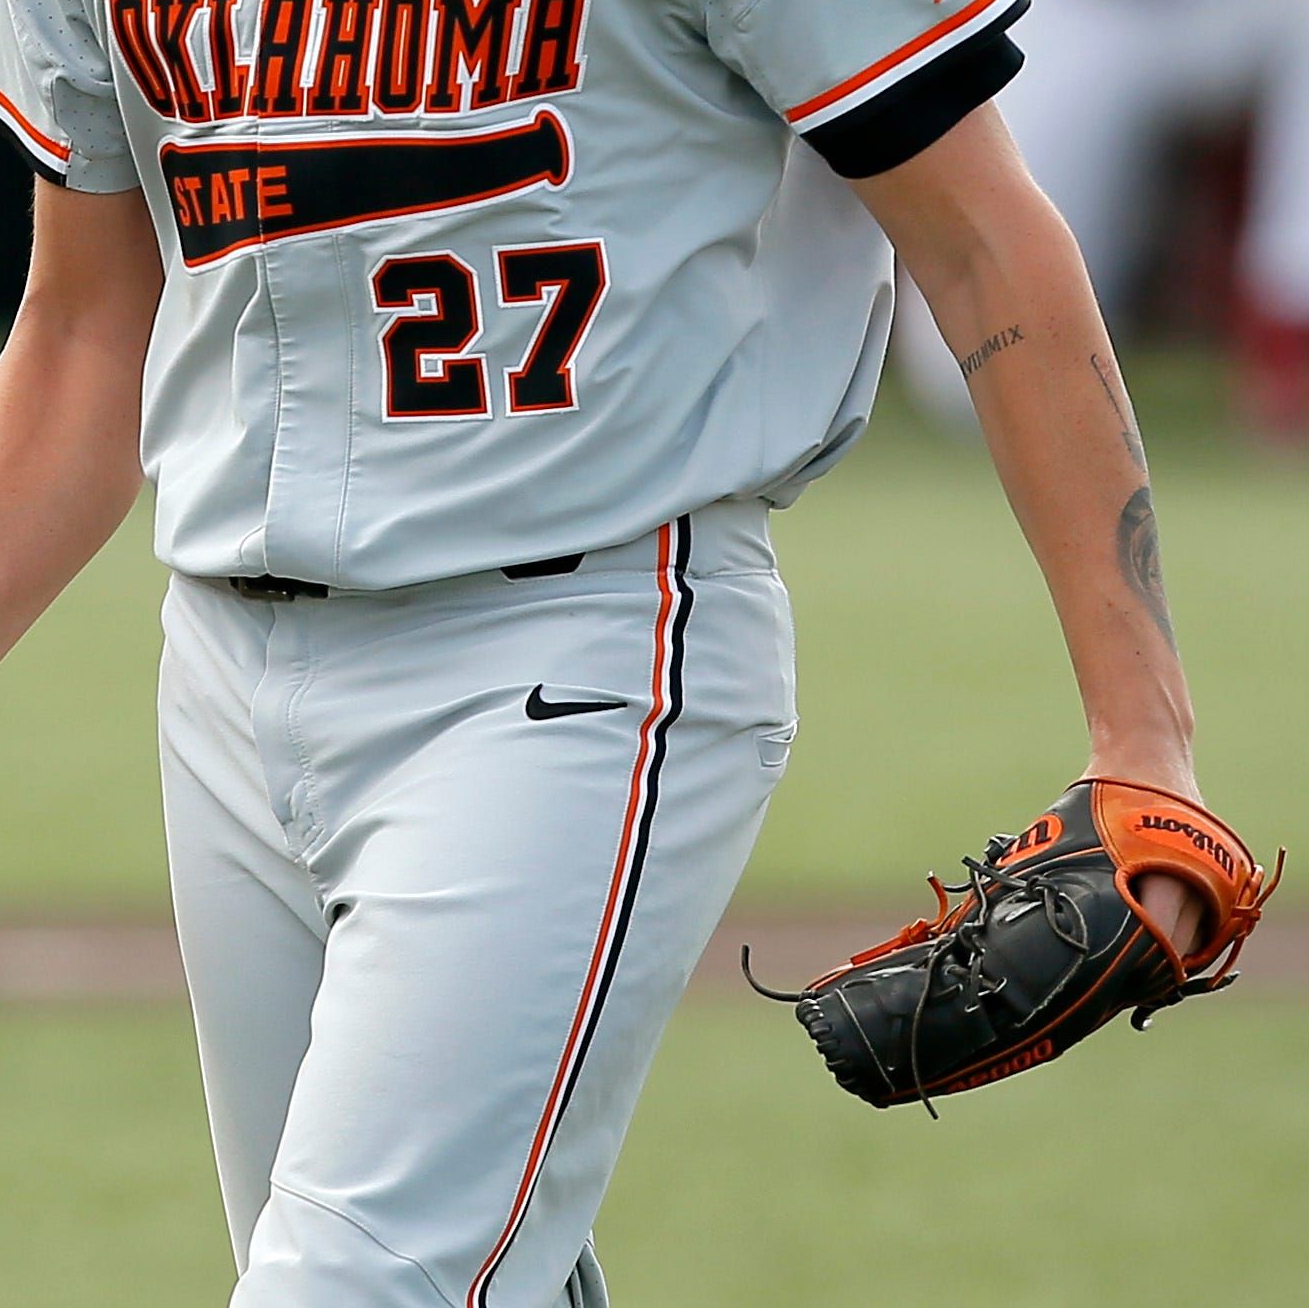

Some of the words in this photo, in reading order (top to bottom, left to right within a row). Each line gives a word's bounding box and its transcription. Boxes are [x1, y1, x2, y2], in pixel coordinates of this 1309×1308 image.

[172, 165, 294, 228] STATE
[370, 238, 611, 423] 27
[1141, 814, 1234, 881] Wilson
